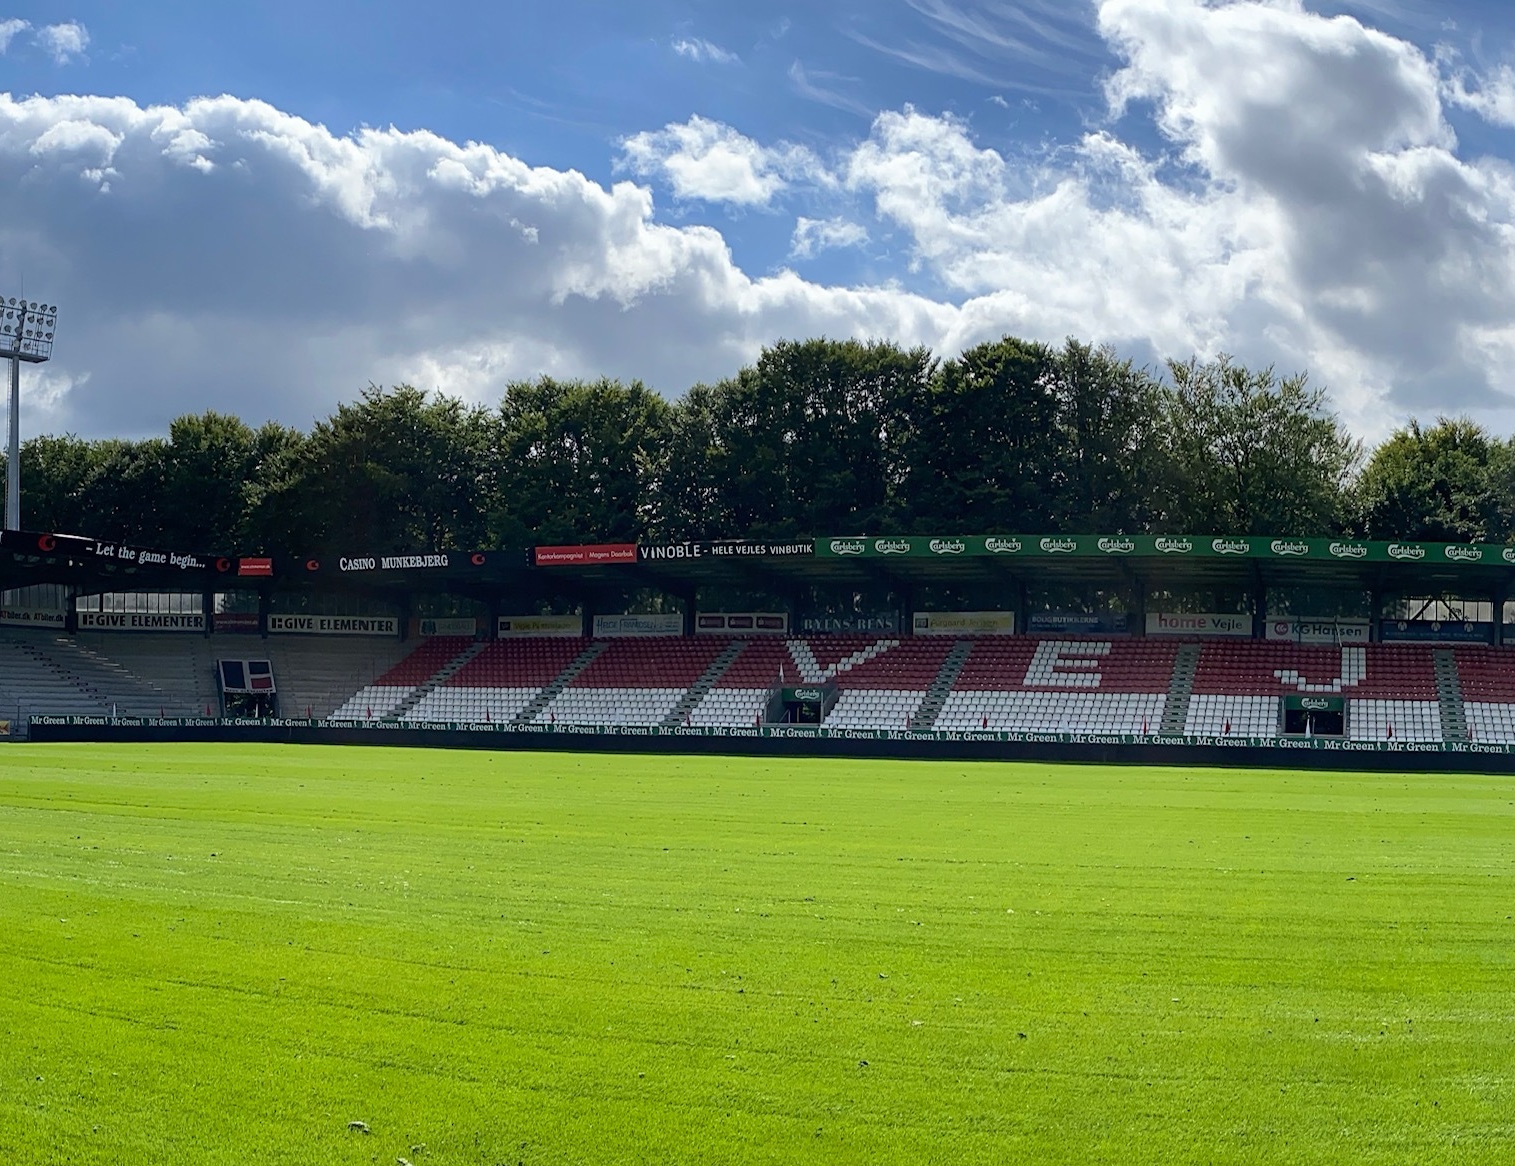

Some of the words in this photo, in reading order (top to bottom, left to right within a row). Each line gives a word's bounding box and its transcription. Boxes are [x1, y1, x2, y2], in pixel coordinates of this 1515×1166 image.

[95, 542, 115, 557] Let
[118, 545, 136, 560] the
[138, 550, 167, 565] game
[640, 544, 702, 560] VINOBLE
[711, 546, 733, 556] HELE
[735, 545, 767, 556] VEJLES
[769, 544, 813, 555] VINBUTIK
[830, 540, 865, 554] Carlsberg
[1271, 540, 1309, 557] Carlsberg
[339, 556, 376, 572] CASINO
[380, 553, 449, 570] MUNKEBJERG
[95, 615, 126, 627] GIVE
[131, 614, 203, 628] ELEMENTER
[284, 617, 313, 630] GIVE
[319, 617, 394, 632] ELEMENTER
[1158, 612, 1207, 630] home
[1212, 617, 1243, 632] Vejle
[1291, 622, 1311, 635] KG
[1312, 622, 1362, 637] Hansen
[1007, 733, 1023, 743] Mr
[1025, 733, 1057, 744] Green
[1323, 740, 1339, 751] Mr
[1342, 741, 1375, 752] Green
